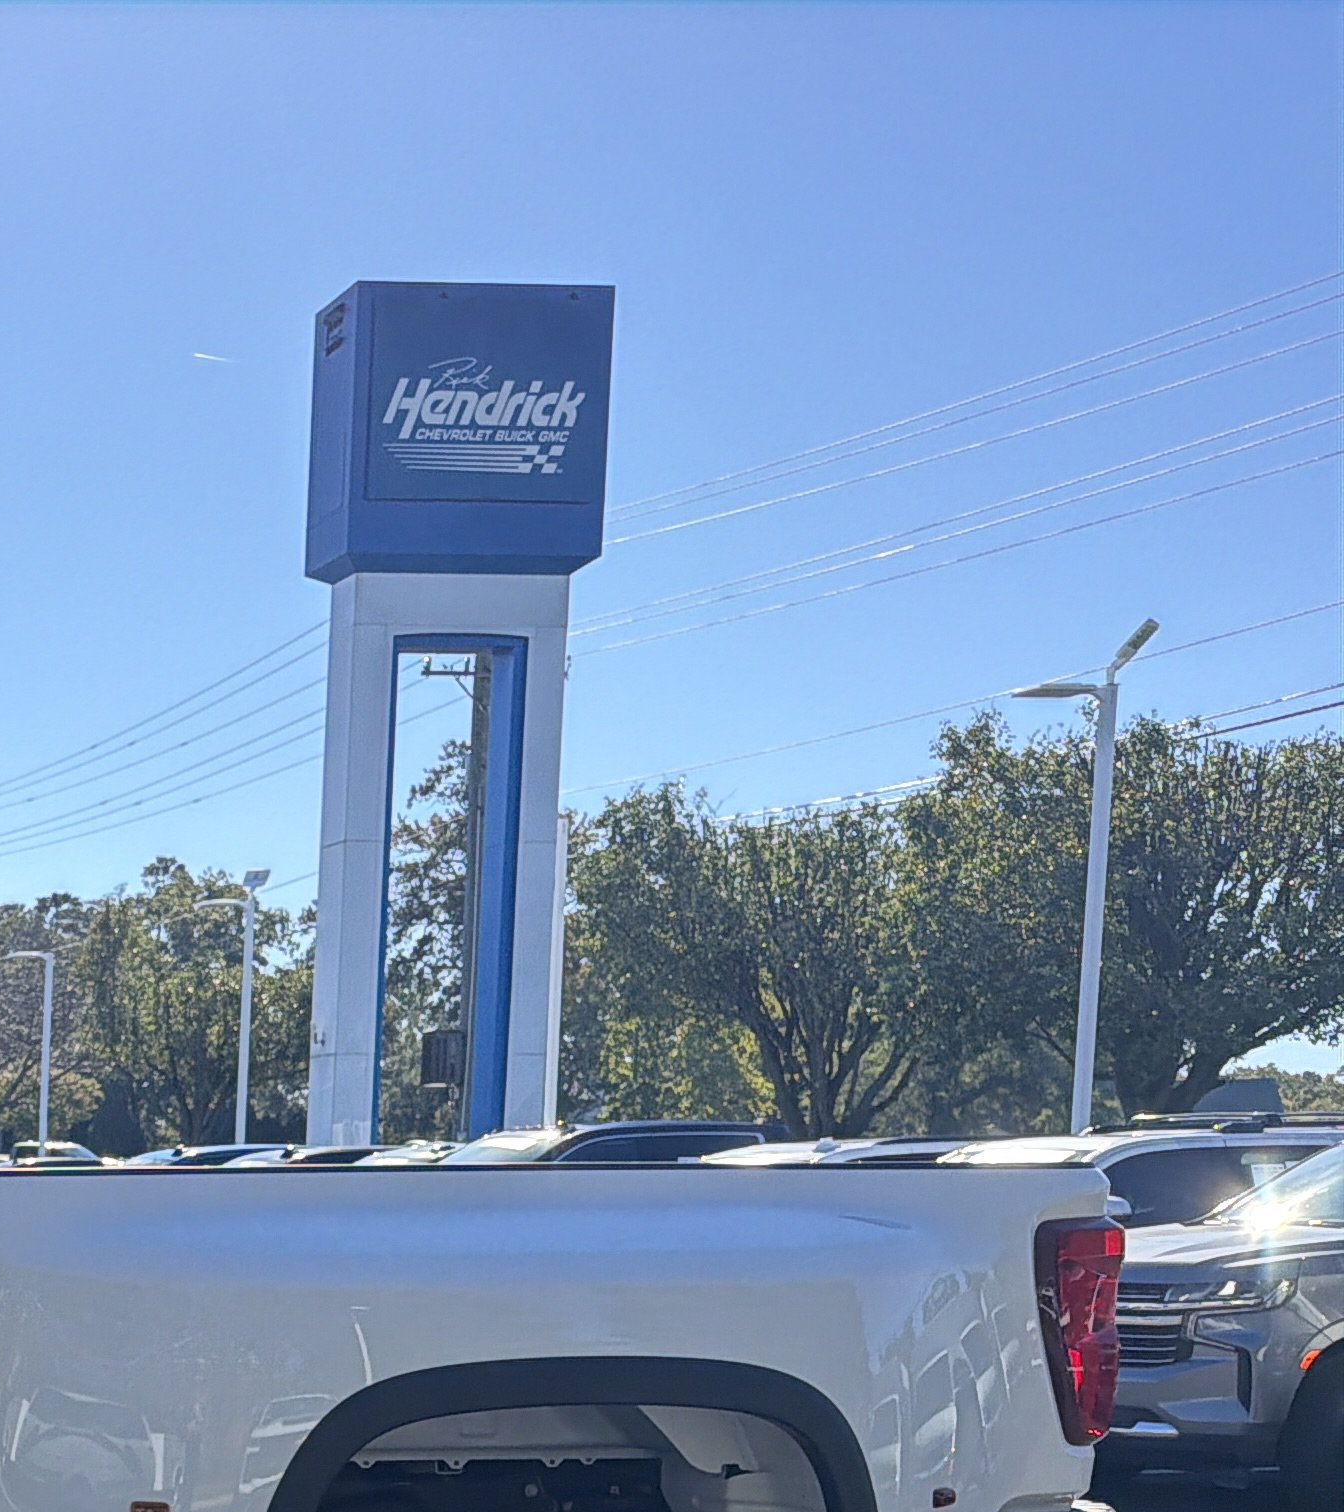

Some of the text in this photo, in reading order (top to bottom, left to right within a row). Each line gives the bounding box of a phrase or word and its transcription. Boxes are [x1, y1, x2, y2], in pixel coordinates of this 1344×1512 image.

[382, 377, 586, 440] Hendrick
[415, 428, 570, 443] CHEVROLET BUICK GMC
